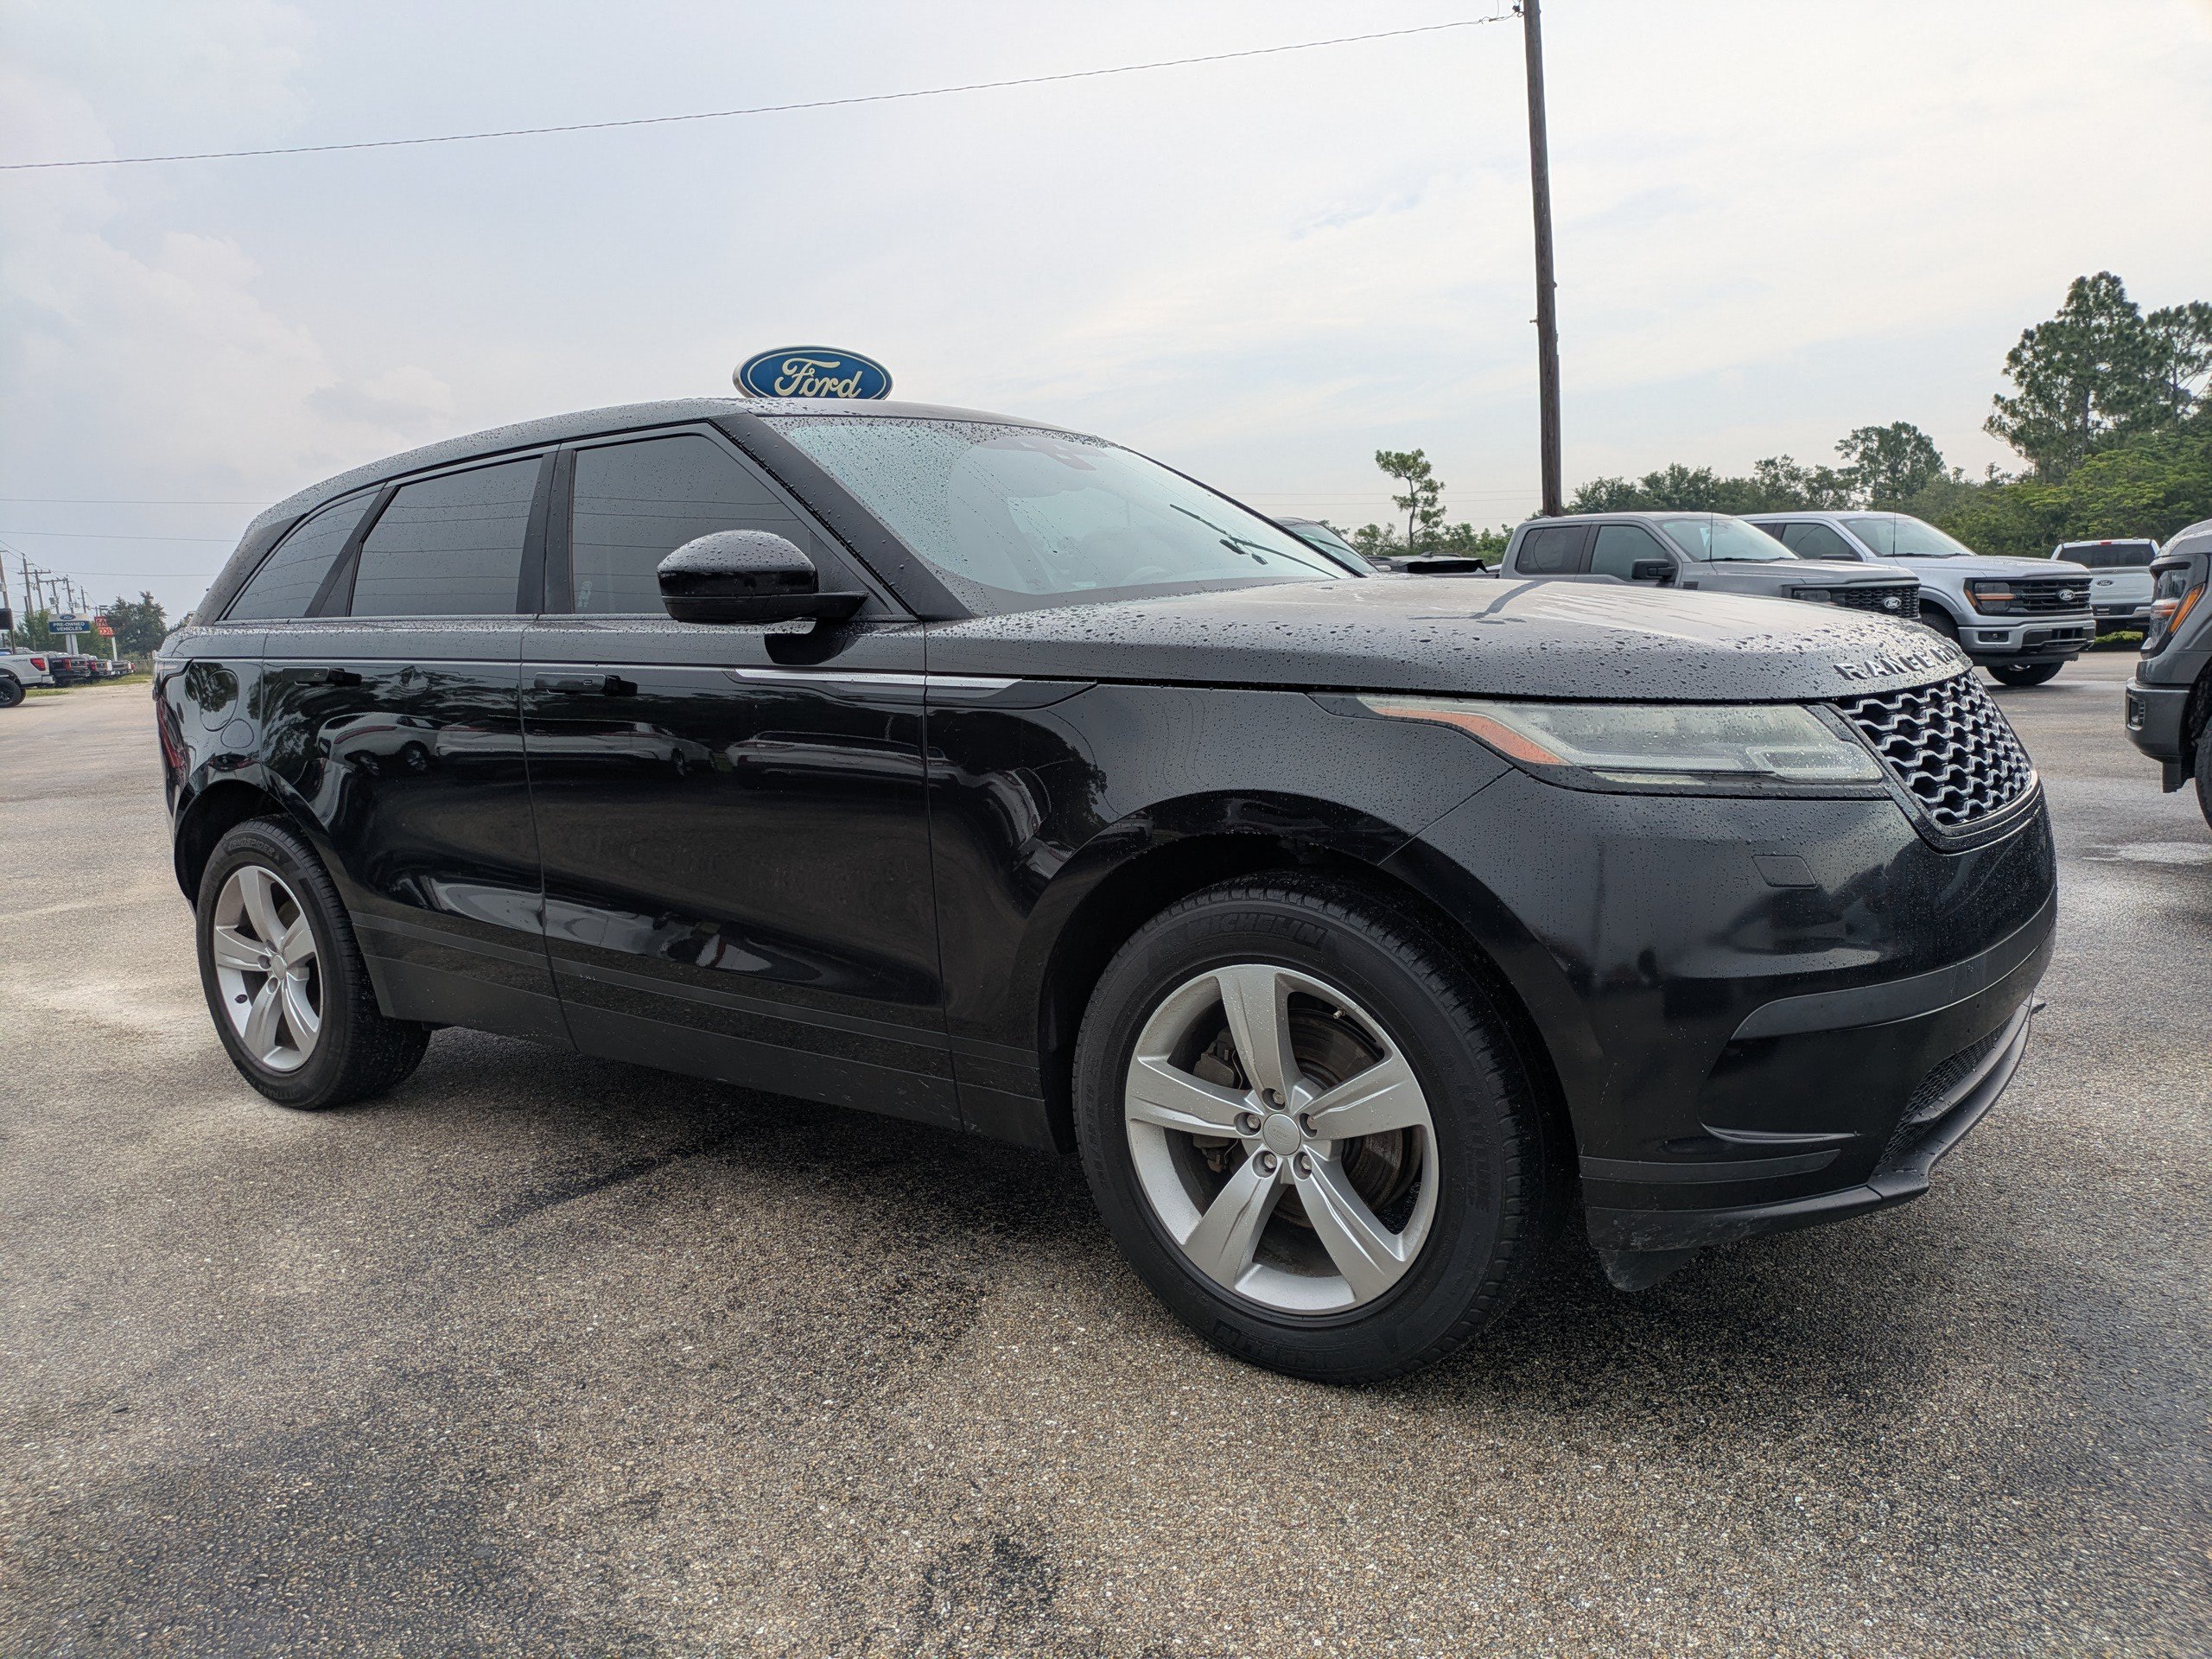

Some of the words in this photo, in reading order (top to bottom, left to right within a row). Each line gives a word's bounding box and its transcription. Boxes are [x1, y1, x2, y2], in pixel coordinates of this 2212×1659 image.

[774, 358, 863, 397] Ford
[1833, 653, 1936, 681] RANGE
[1186, 912, 1327, 948] MICHELIN
